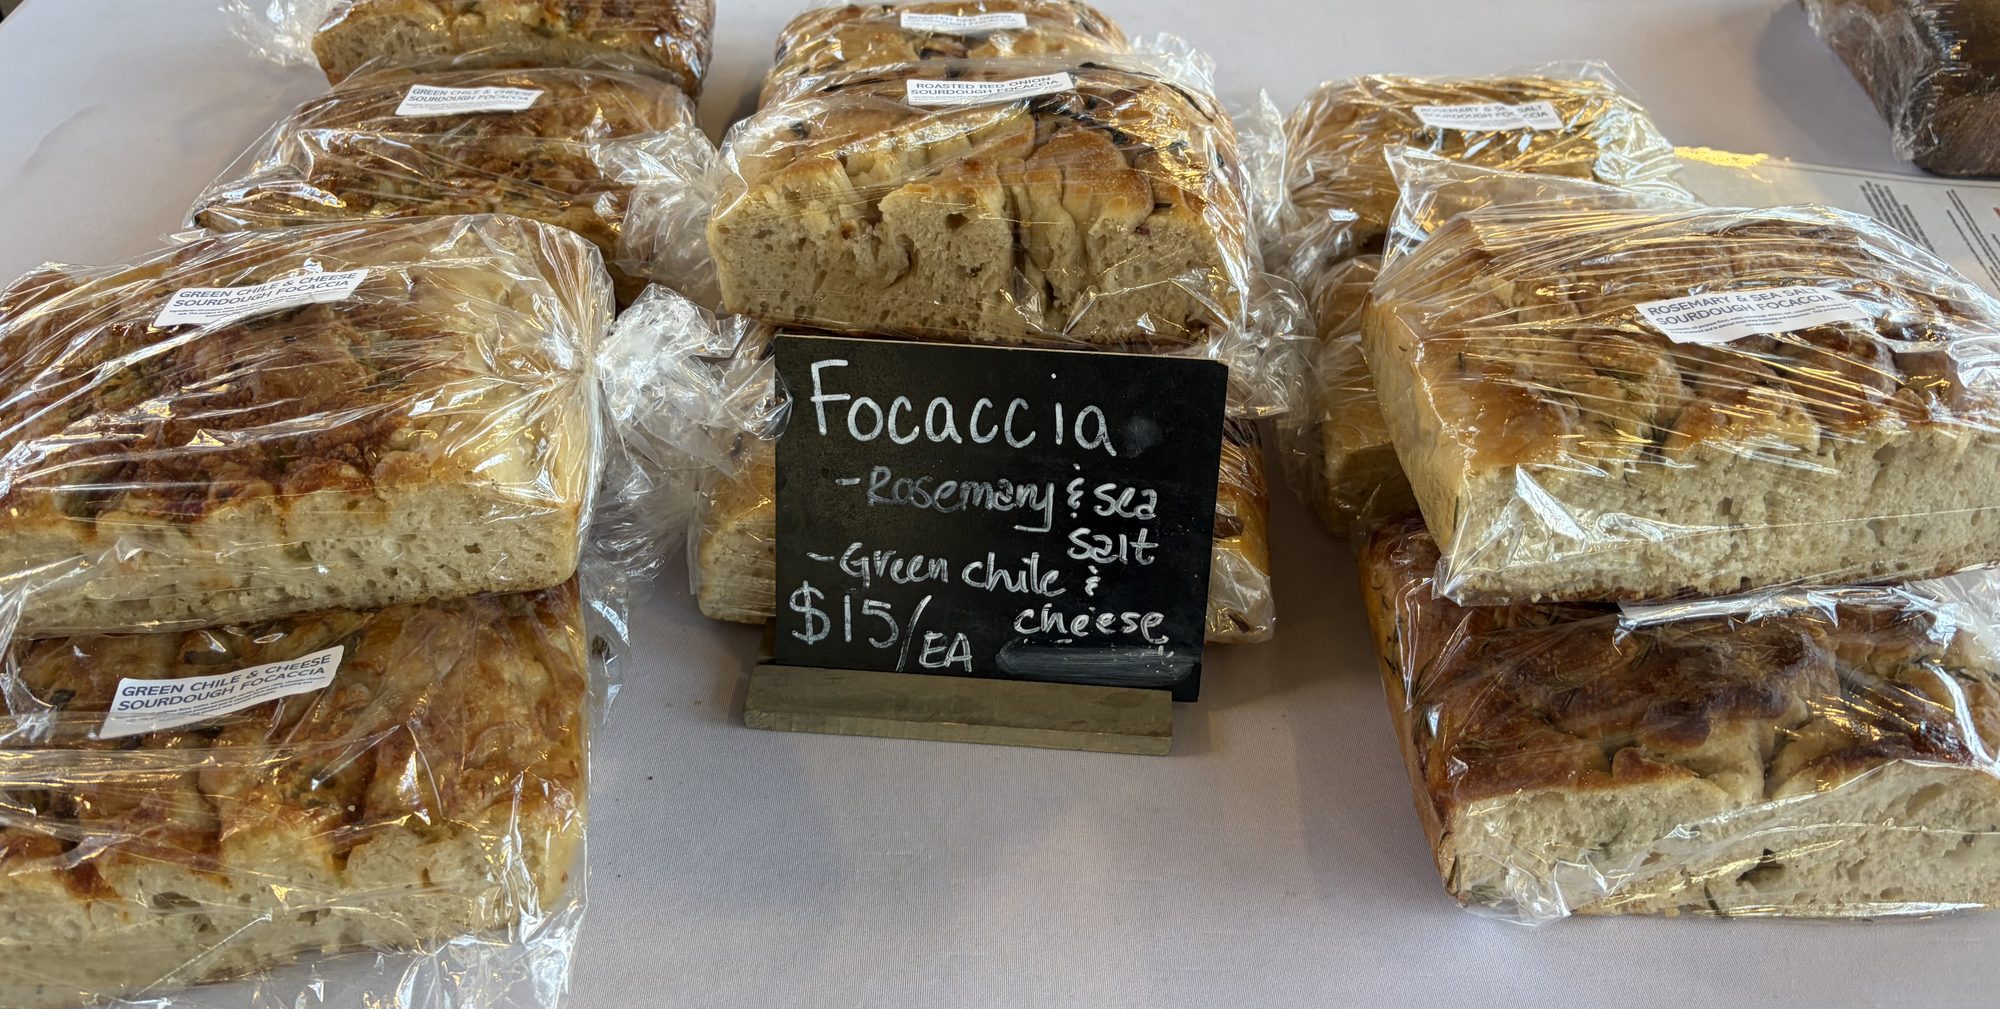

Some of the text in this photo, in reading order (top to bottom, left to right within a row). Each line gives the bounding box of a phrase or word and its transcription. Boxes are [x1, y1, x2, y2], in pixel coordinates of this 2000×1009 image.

[412, 88, 448, 96] GREEN
[996, 80, 1059, 93] FOCACCIA
[1009, 76, 1052, 87] ONION
[408, 95, 476, 103] SOURDOUGH
[173, 290, 272, 307] SOURDOUGH
[276, 280, 349, 295] FOCACCIA
[179, 272, 358, 299] GREEN CHILE & CHEESE
[1648, 286, 1820, 316] ROSEMARY & SEA SALT
[1656, 303, 1757, 327] SOURDOUGH
[1759, 293, 1834, 312] FOCACCIA
[810, 358, 1117, 456] Focaccia
[1094, 483, 1158, 520] sea
[1067, 527, 1160, 565] salt
[961, 551, 1066, 596] chile
[1013, 603, 1170, 645] cheese
[118, 685, 236, 711] SOURDOUGH
[240, 666, 325, 690] FOCACCIA
[121, 654, 332, 698] GREEN CHILE & CHEESE
